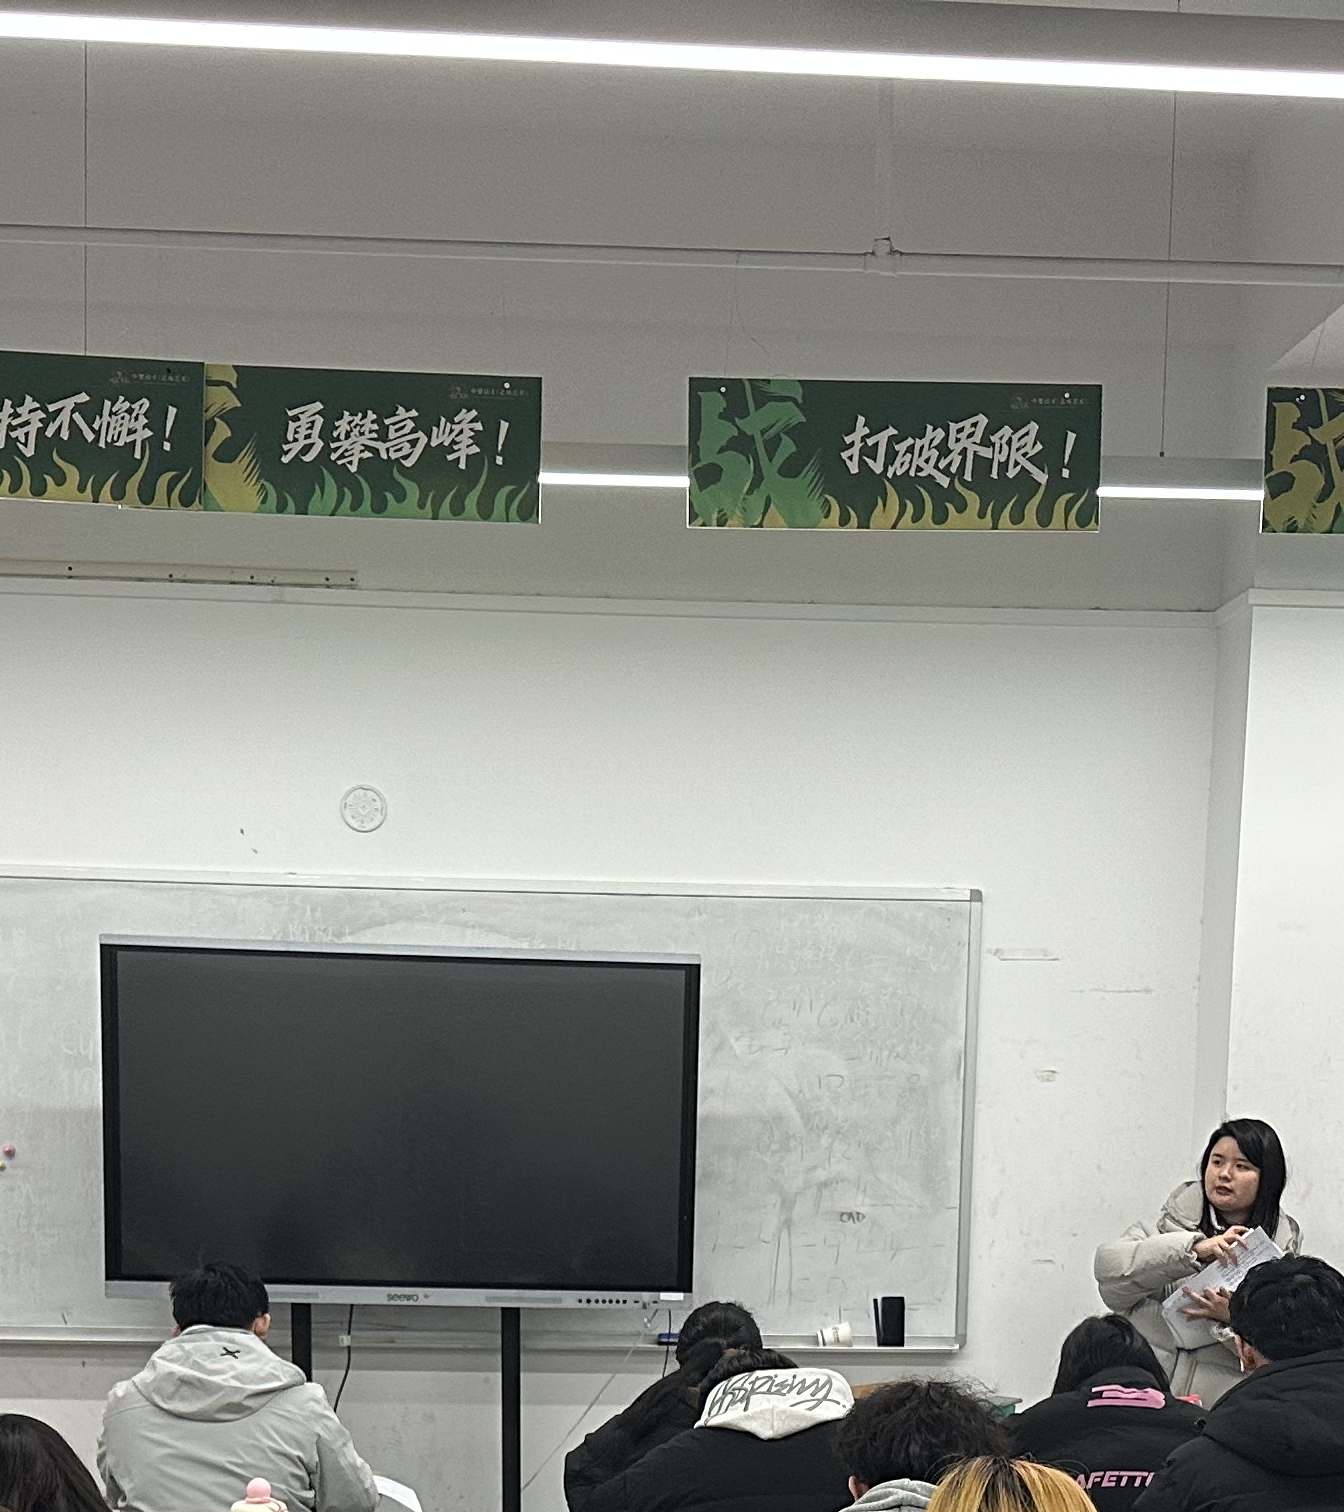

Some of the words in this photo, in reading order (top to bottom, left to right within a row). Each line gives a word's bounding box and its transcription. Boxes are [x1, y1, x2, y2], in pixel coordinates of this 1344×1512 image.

[280, 402, 510, 473] 勇攀高峰！
[841, 413, 1076, 488] 打破界限！
